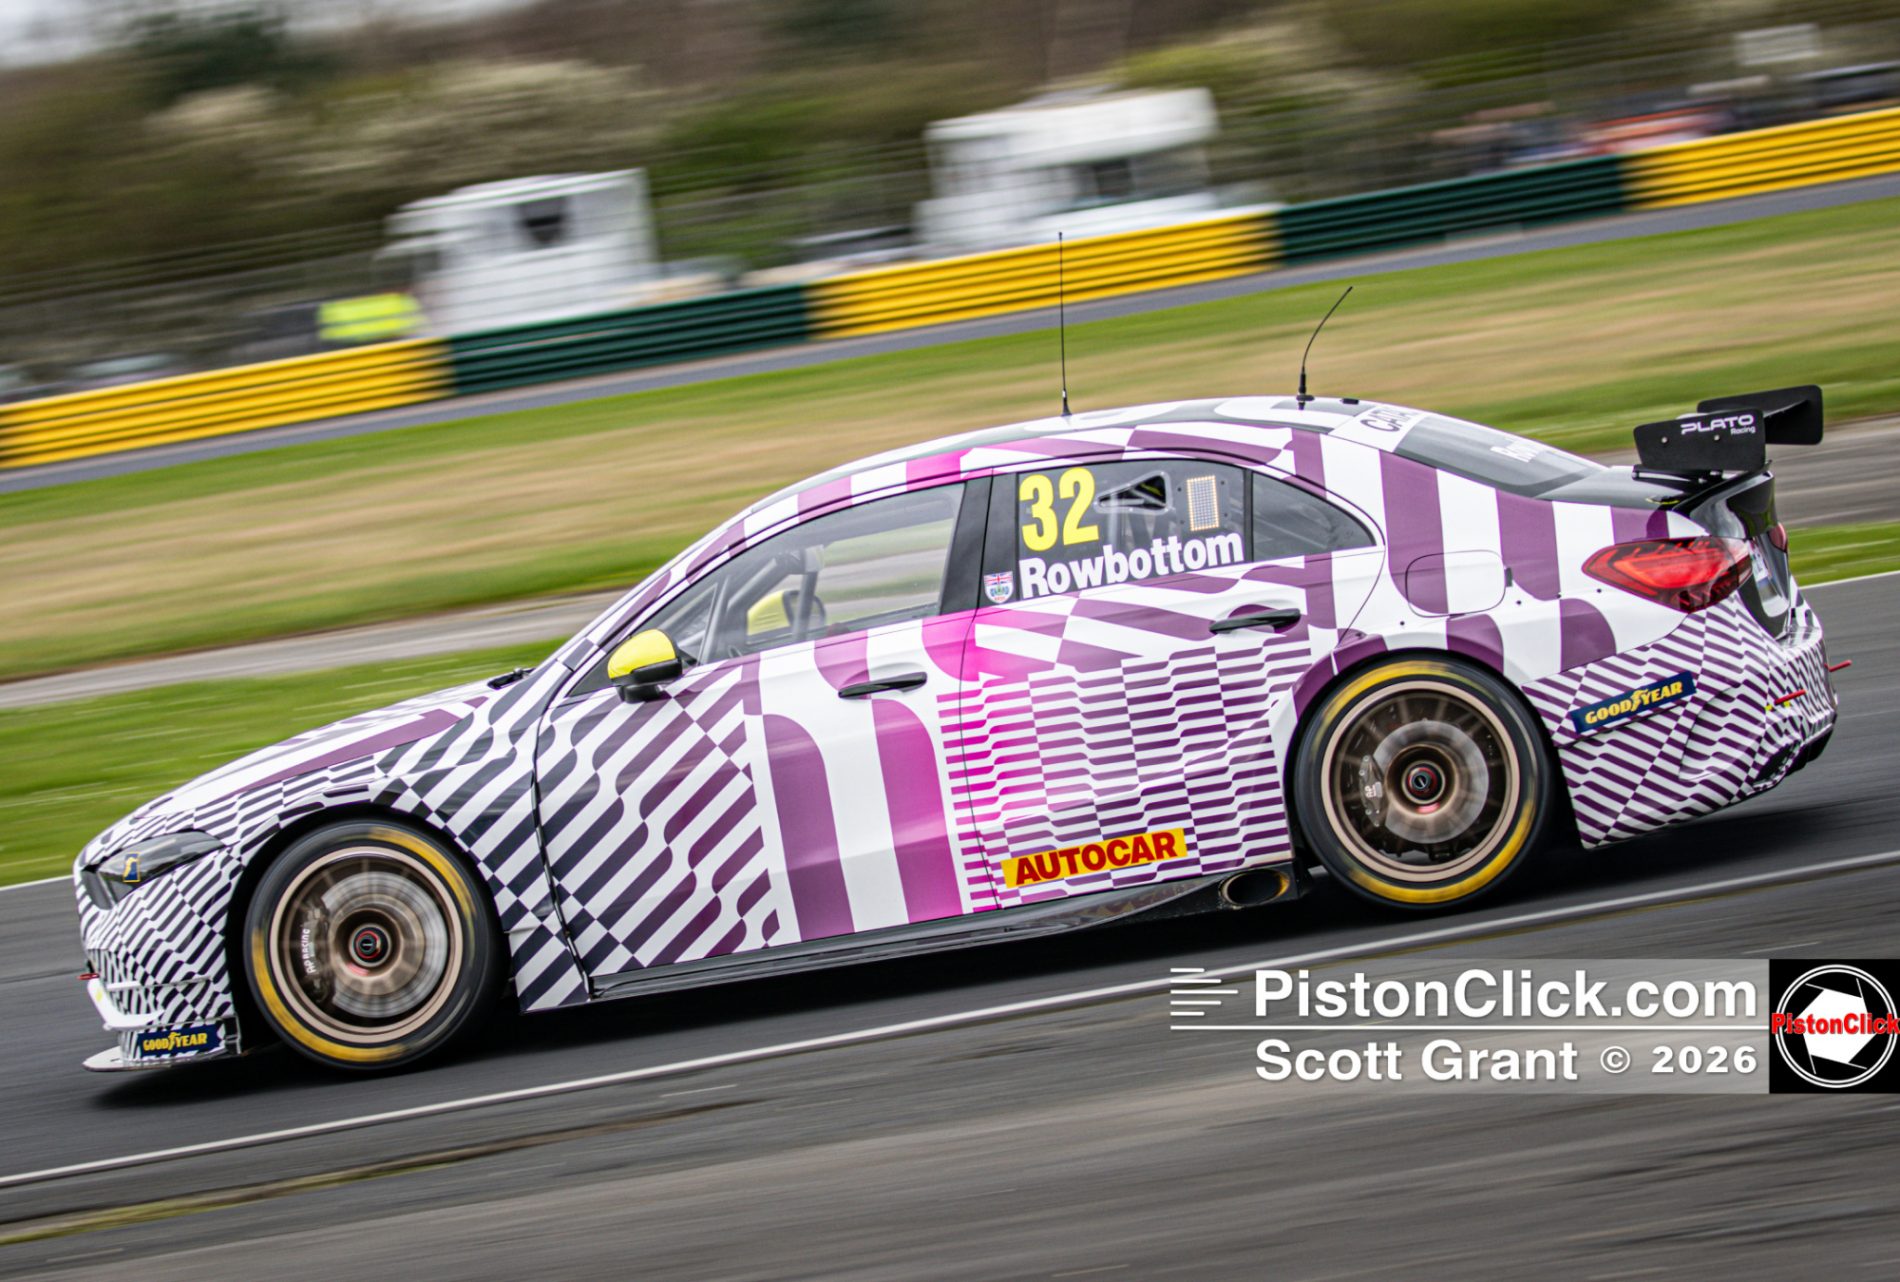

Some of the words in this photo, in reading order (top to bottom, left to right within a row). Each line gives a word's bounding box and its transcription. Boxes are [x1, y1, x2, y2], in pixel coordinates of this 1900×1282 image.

[1681, 414, 1754, 434] PLATO
[1730, 426, 1756, 435] Racing
[1018, 467, 1099, 552] 32
[1019, 532, 1244, 599] Rowbottom
[1585, 681, 1683, 724] GOODYEAR
[1016, 831, 1177, 885] AUTOCAR
[143, 1032, 208, 1051] GOODYEAR
